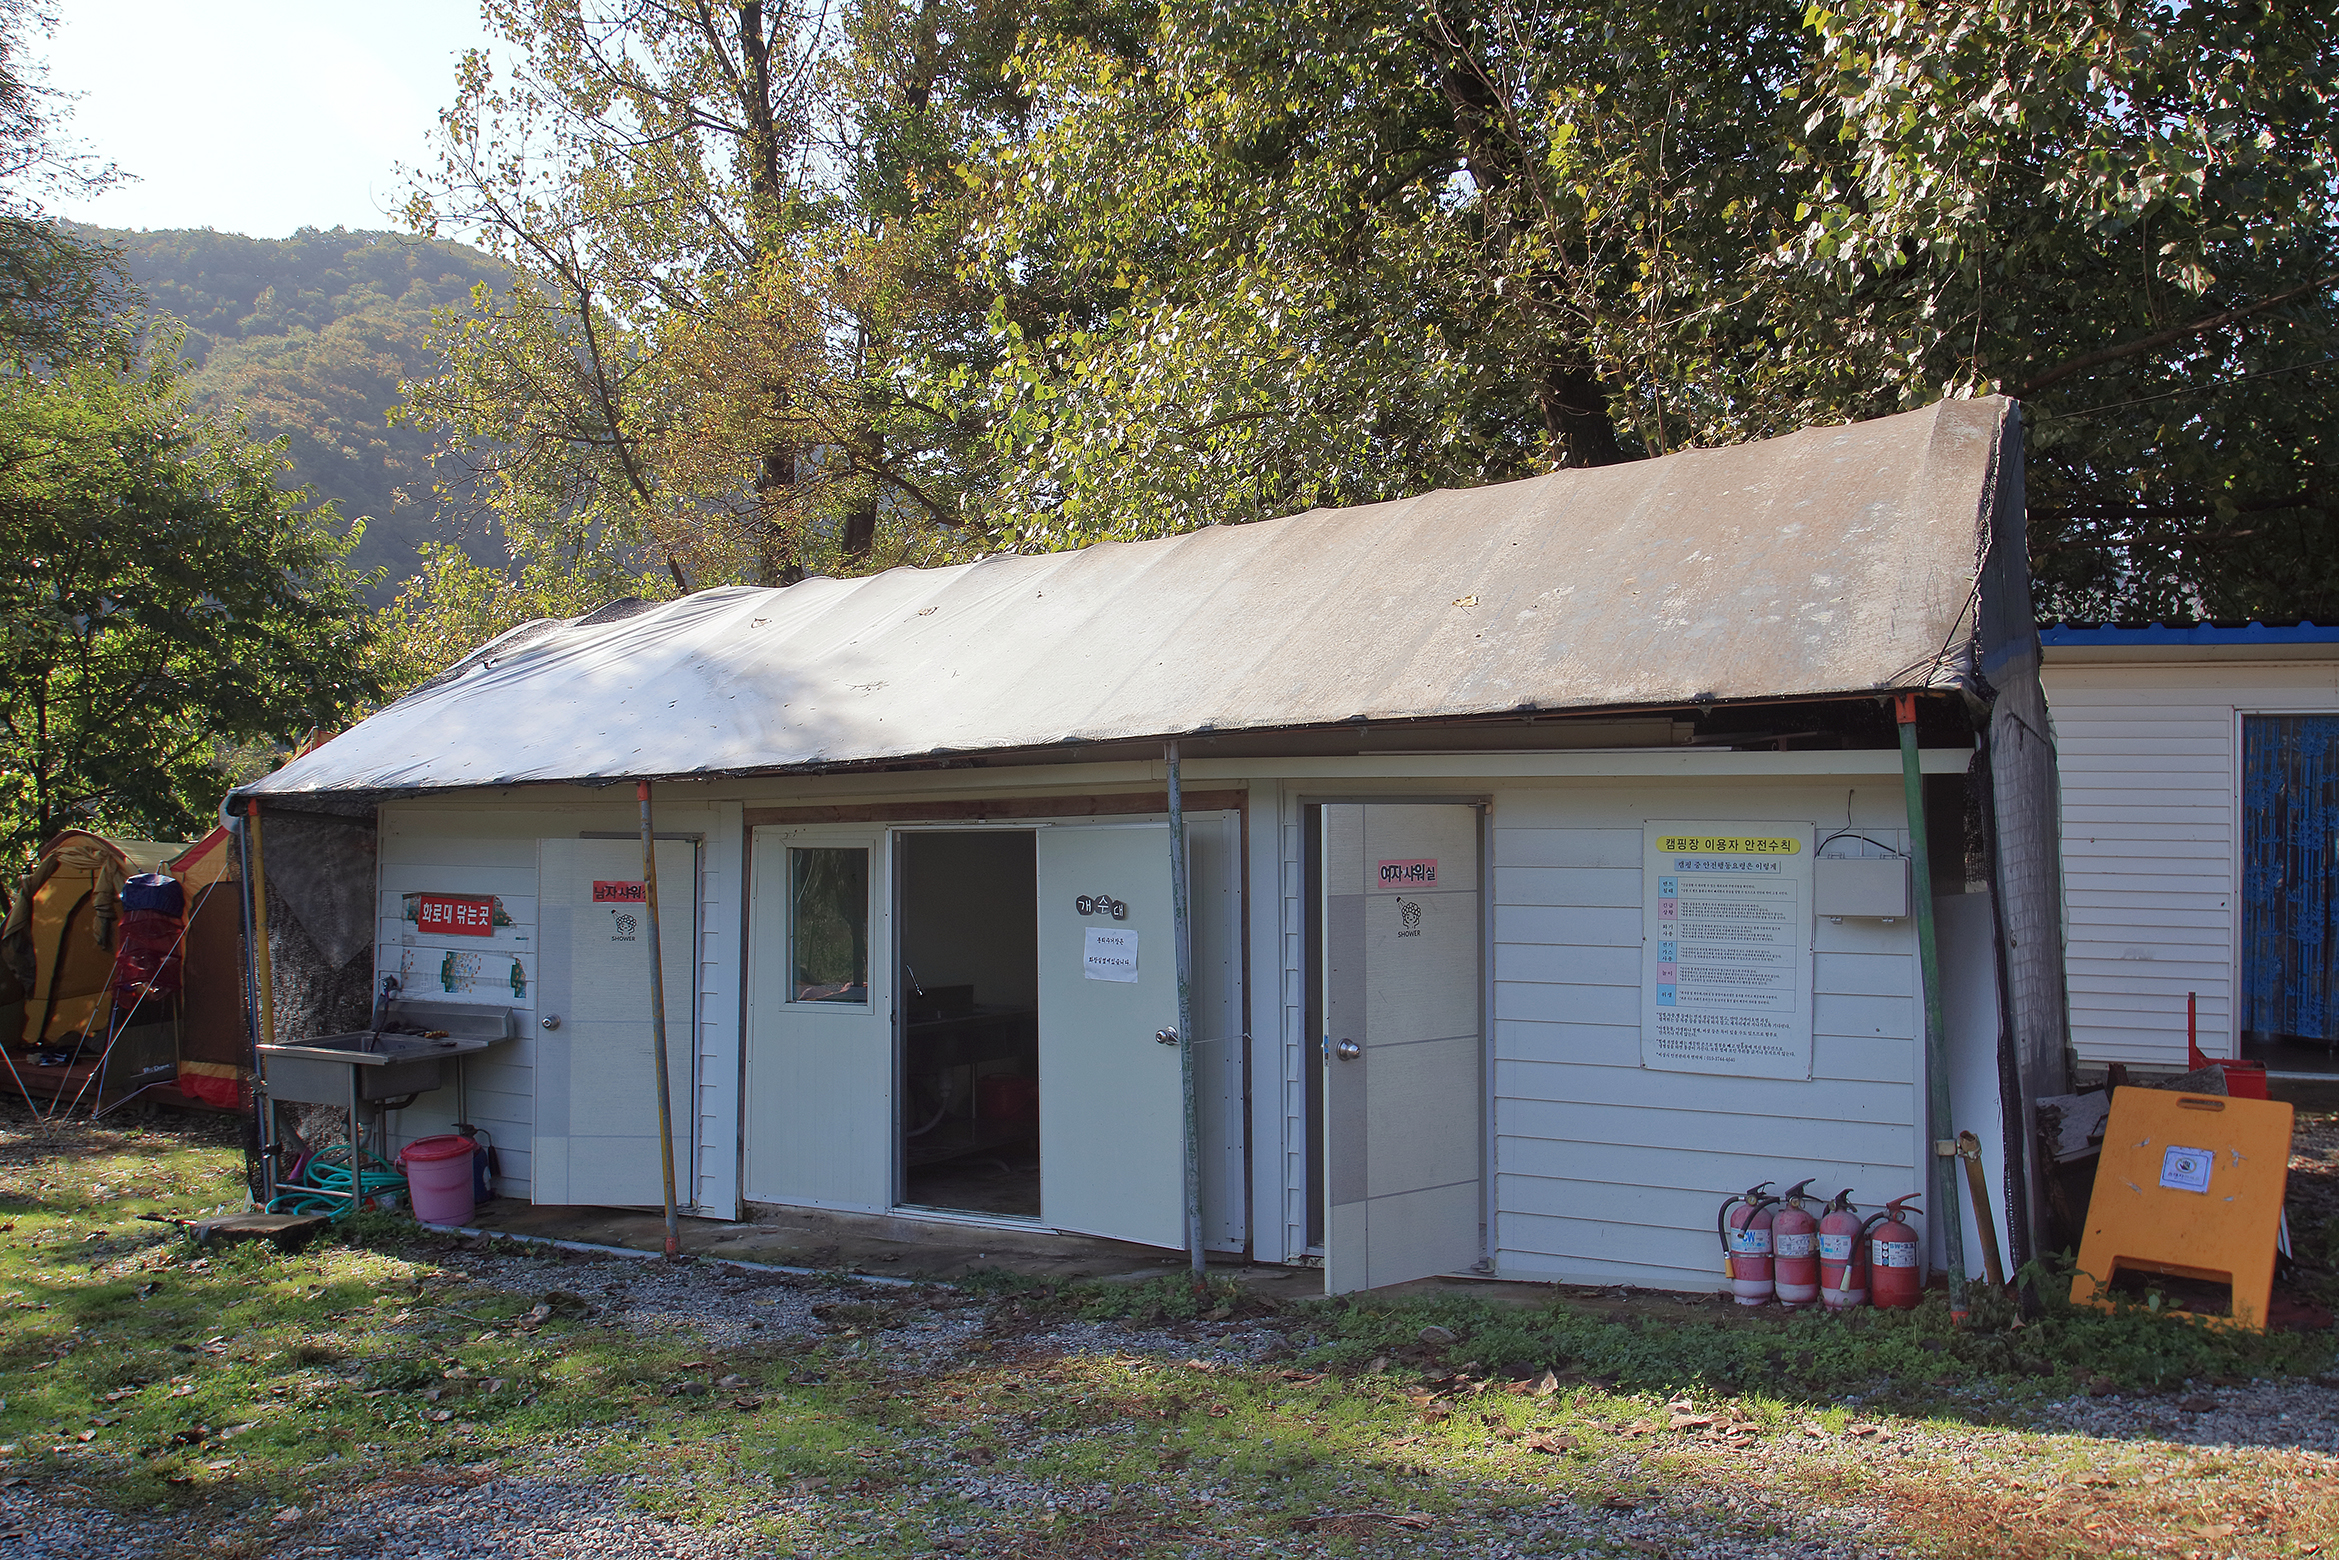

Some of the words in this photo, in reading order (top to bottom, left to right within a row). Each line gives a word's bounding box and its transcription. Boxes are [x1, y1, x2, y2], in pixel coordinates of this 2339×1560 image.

[1665, 838, 1698, 850] 캠핑장
[1705, 838, 1738, 851] 이용자
[1744, 839, 1790, 852] 안전수칙
[1380, 864, 1403, 883] 여자
[1404, 863, 1436, 882] 샤워실
[1678, 860, 1691, 869] 캠핑
[1694, 860, 1701, 869] 중
[1755, 862, 1776, 871] 이렇게
[594, 885, 617, 900] 남자
[619, 885, 646, 899] 샤워
[422, 902, 453, 924] 화로대
[456, 904, 489, 926] 닦는곳
[1078, 896, 1123, 917] 개수대
[1397, 930, 1421, 938] SHOWER
